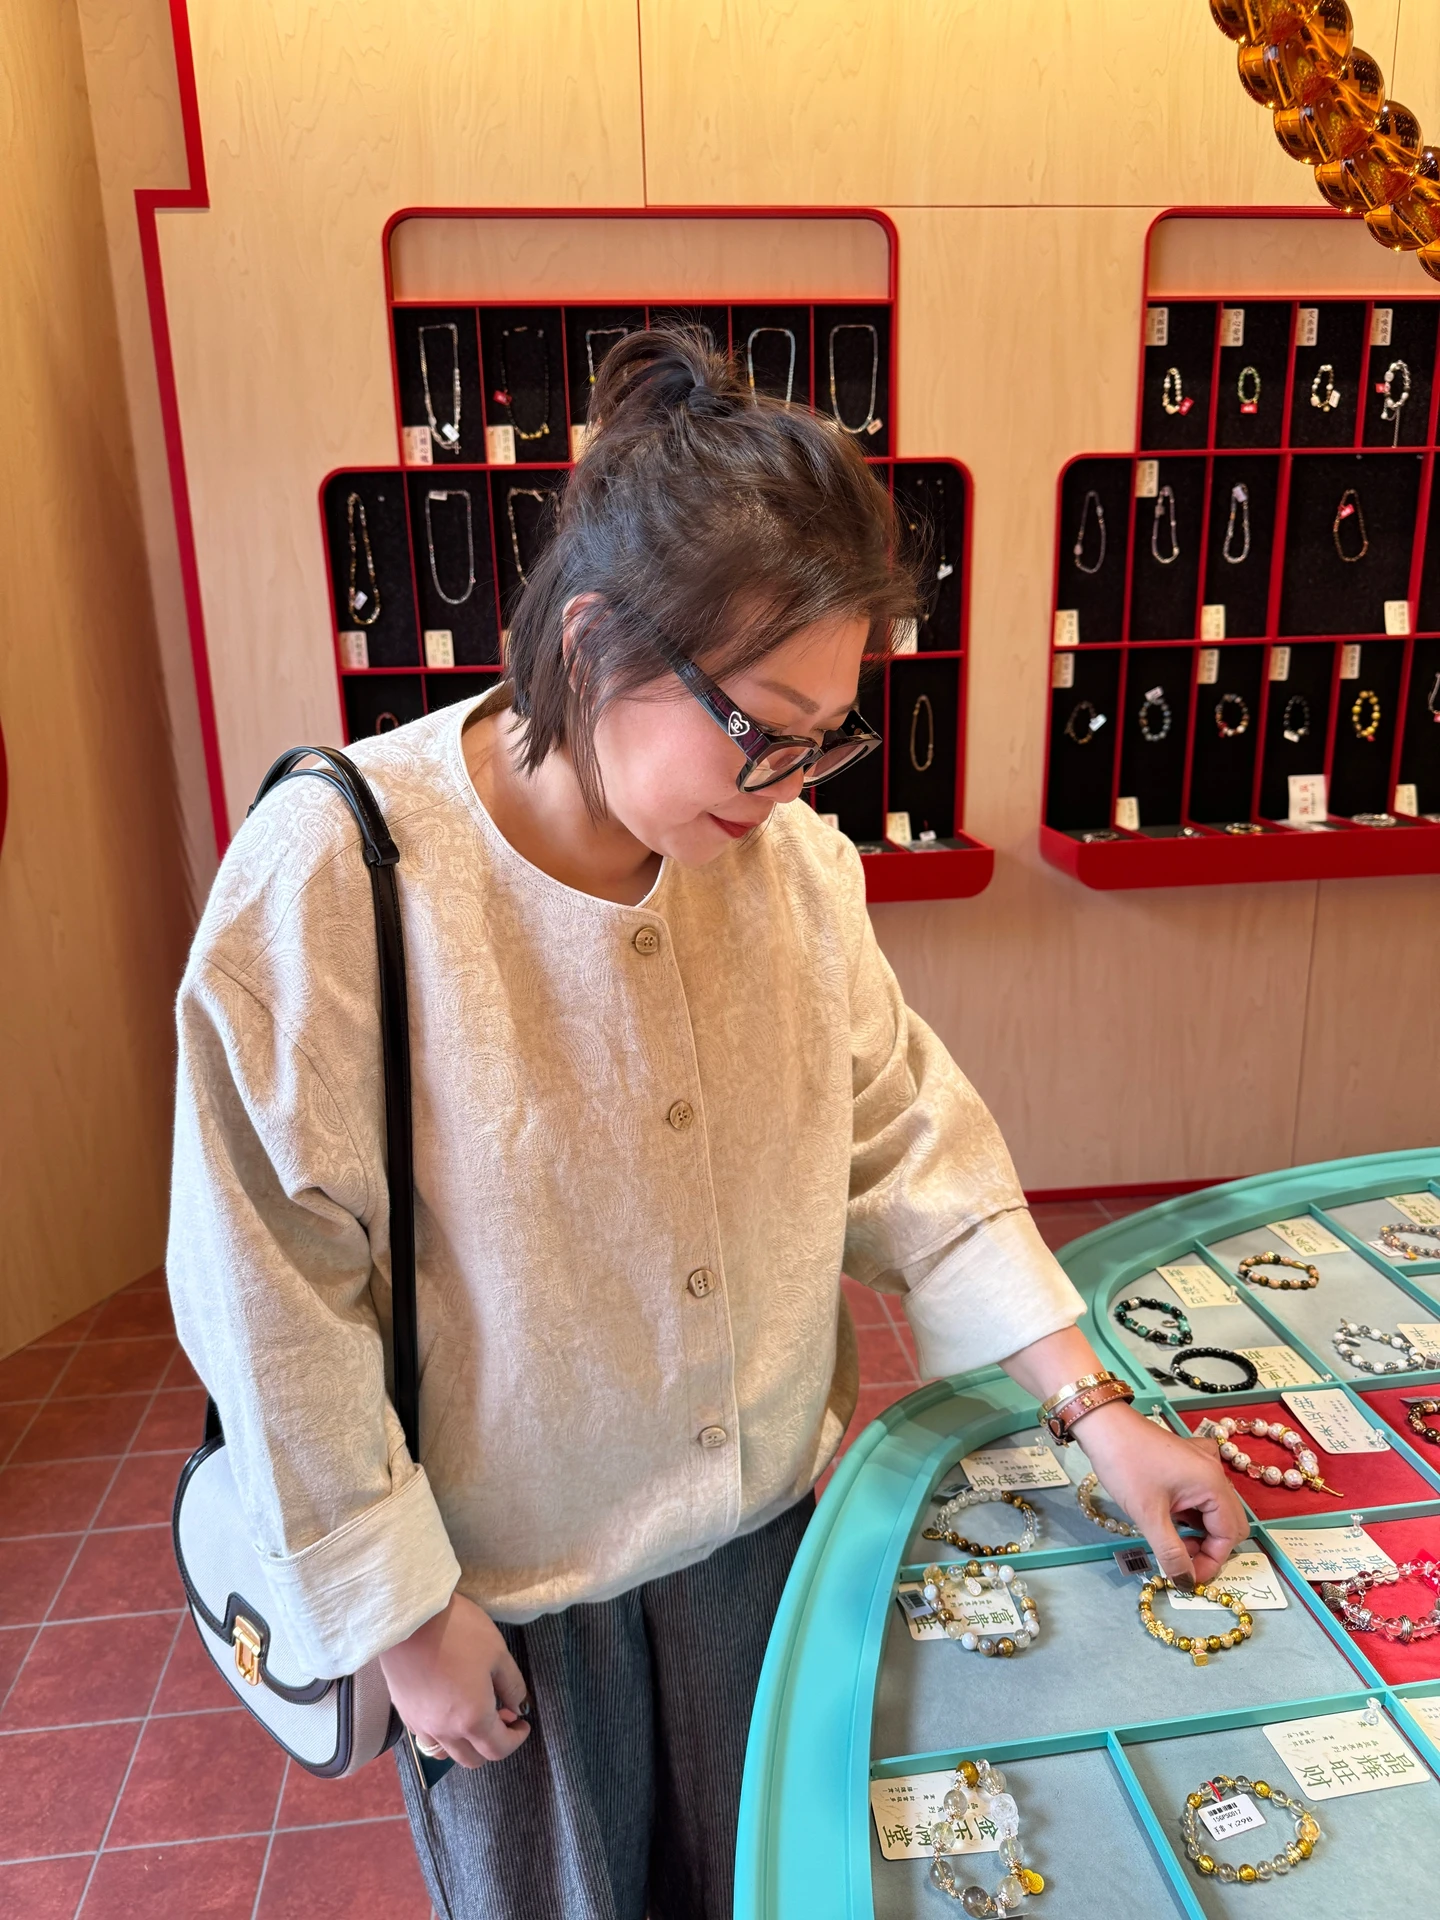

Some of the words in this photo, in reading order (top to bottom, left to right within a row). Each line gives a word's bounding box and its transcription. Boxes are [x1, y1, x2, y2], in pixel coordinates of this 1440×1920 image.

[1292, 1396, 1349, 1452] 时来运转
[971, 1469, 1063, 1488] 招财进宝
[1174, 1585, 1278, 1604] 万金身
[1295, 1751, 1416, 1790] 晶辉旺财
[882, 1814, 999, 1849] 金玉满堂
